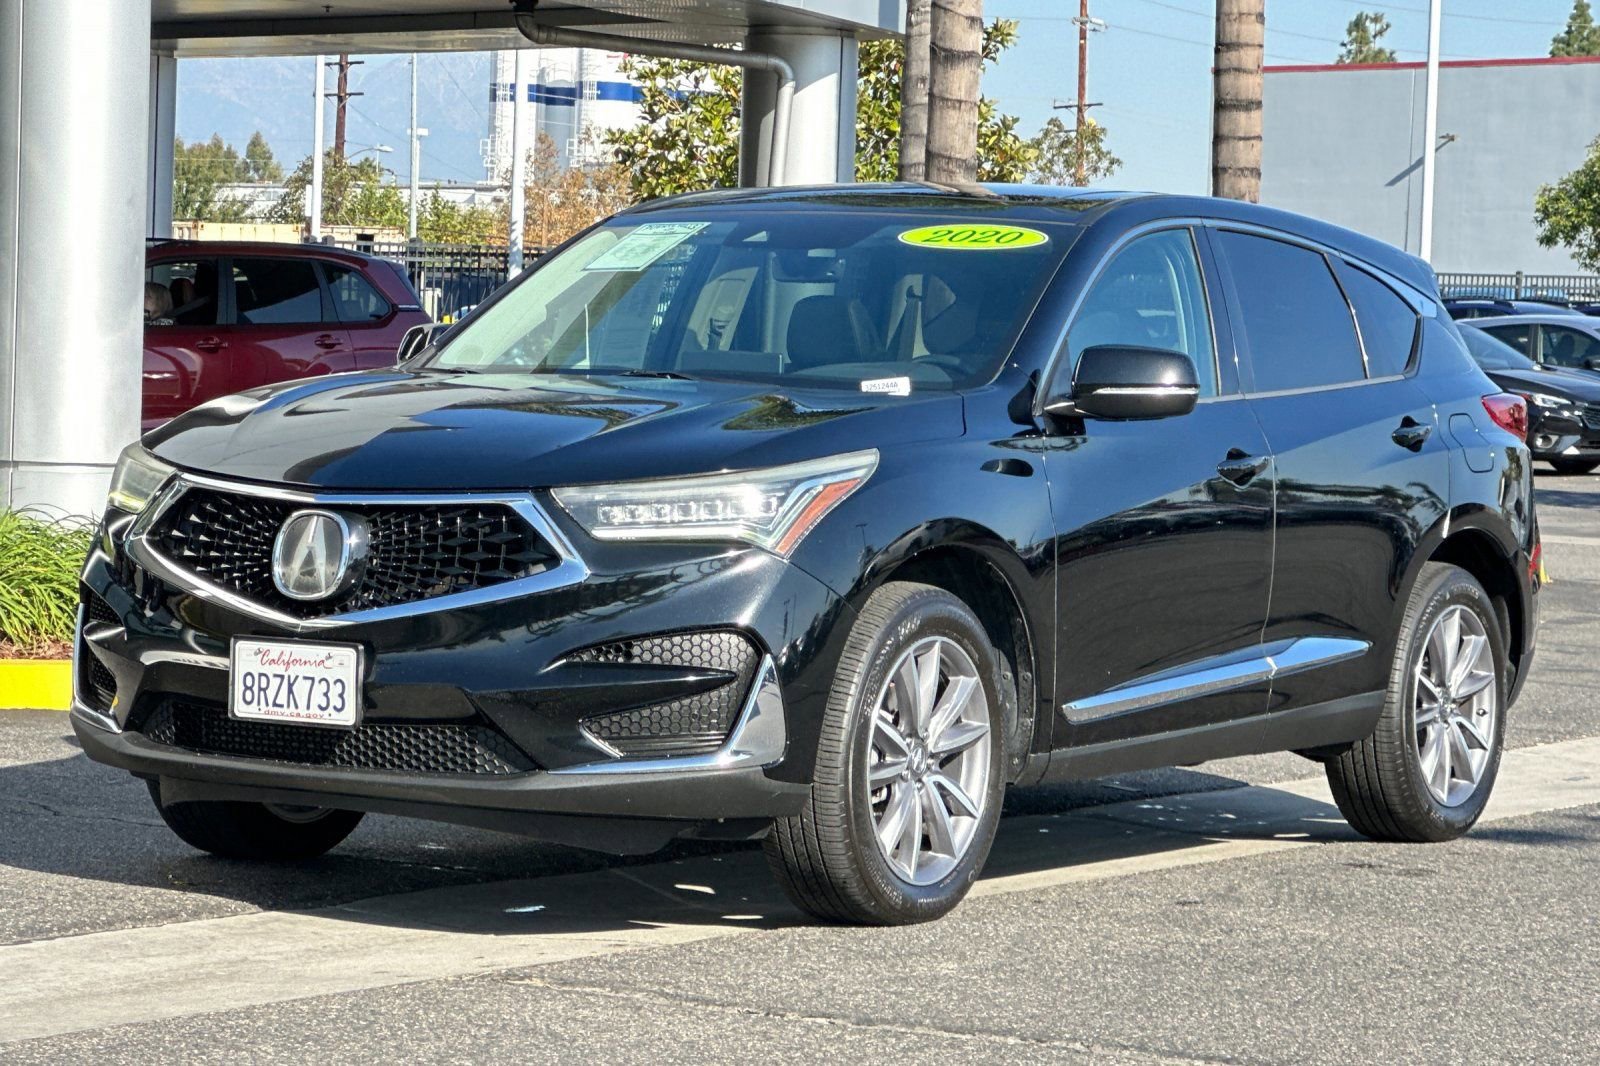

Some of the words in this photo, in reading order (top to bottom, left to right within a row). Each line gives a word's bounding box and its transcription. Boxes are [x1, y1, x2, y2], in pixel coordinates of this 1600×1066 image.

[921, 229, 1025, 243] 2020
[260, 648, 333, 672] California
[242, 671, 346, 713] 8RZK733
[264, 708, 325, 719] dmv.ca.gov
